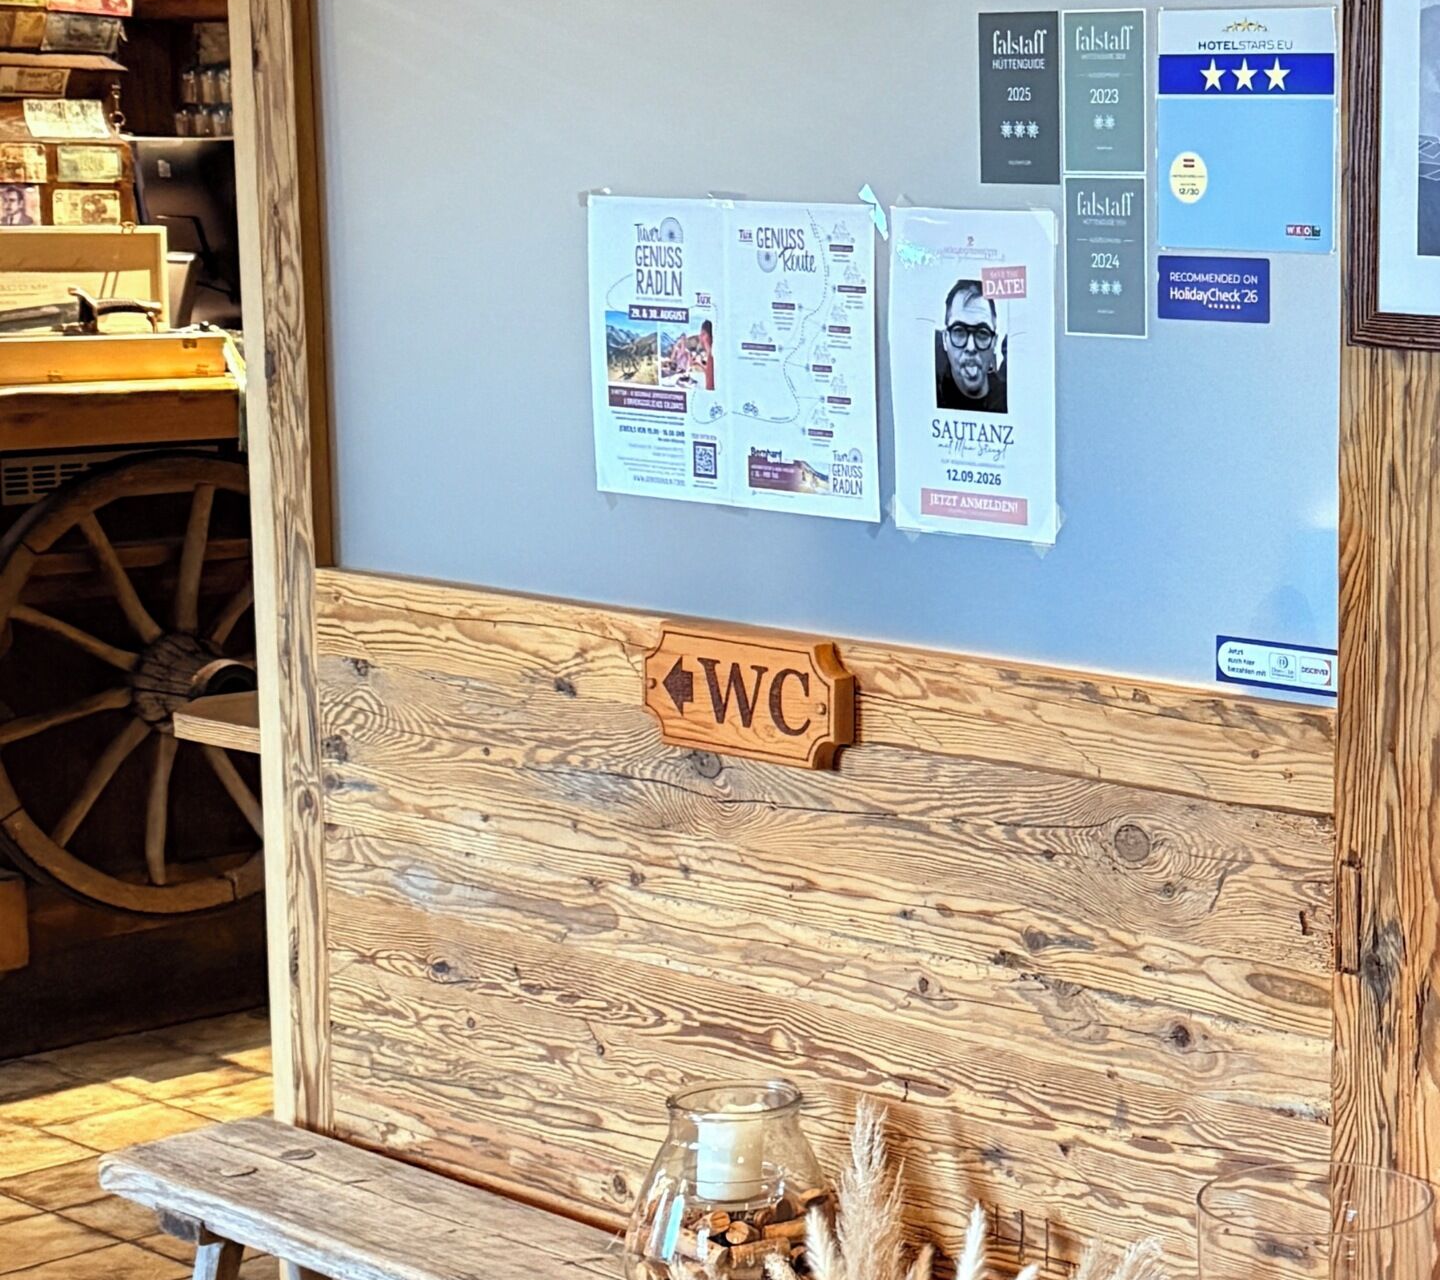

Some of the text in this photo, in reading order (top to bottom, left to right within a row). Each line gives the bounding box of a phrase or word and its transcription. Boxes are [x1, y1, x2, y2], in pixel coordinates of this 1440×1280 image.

[993, 29, 1047, 55] falstaff
[1076, 25, 1133, 51] falstaff
[1198, 40, 1293, 51] HOTELSTARS.EU
[992, 57, 1045, 70] HÜTTENGUIDE
[1007, 87, 1032, 101] 2025
[1089, 88, 1119, 104] 2023
[1077, 191, 1134, 216] falstaff
[756, 227, 805, 250] GENUSS
[635, 245, 683, 269] GENUSS
[778, 247, 816, 273] Route
[1091, 253, 1120, 269] 2024
[636, 268, 682, 297] RADLN
[1170, 272, 1258, 284] RECOMMENDED ON
[986, 279, 1025, 295] DATE!
[1170, 287, 1240, 305] HolidayCheck
[660, 310, 687, 321] AUGUST
[931, 419, 1015, 445] SAUTANZ
[832, 464, 863, 479] GENUSS
[946, 469, 1002, 486] 12.09.2026
[832, 478, 863, 495] RADLN
[929, 493, 1018, 513] JETZT ANMELDEN!
[696, 657, 811, 737] WC
